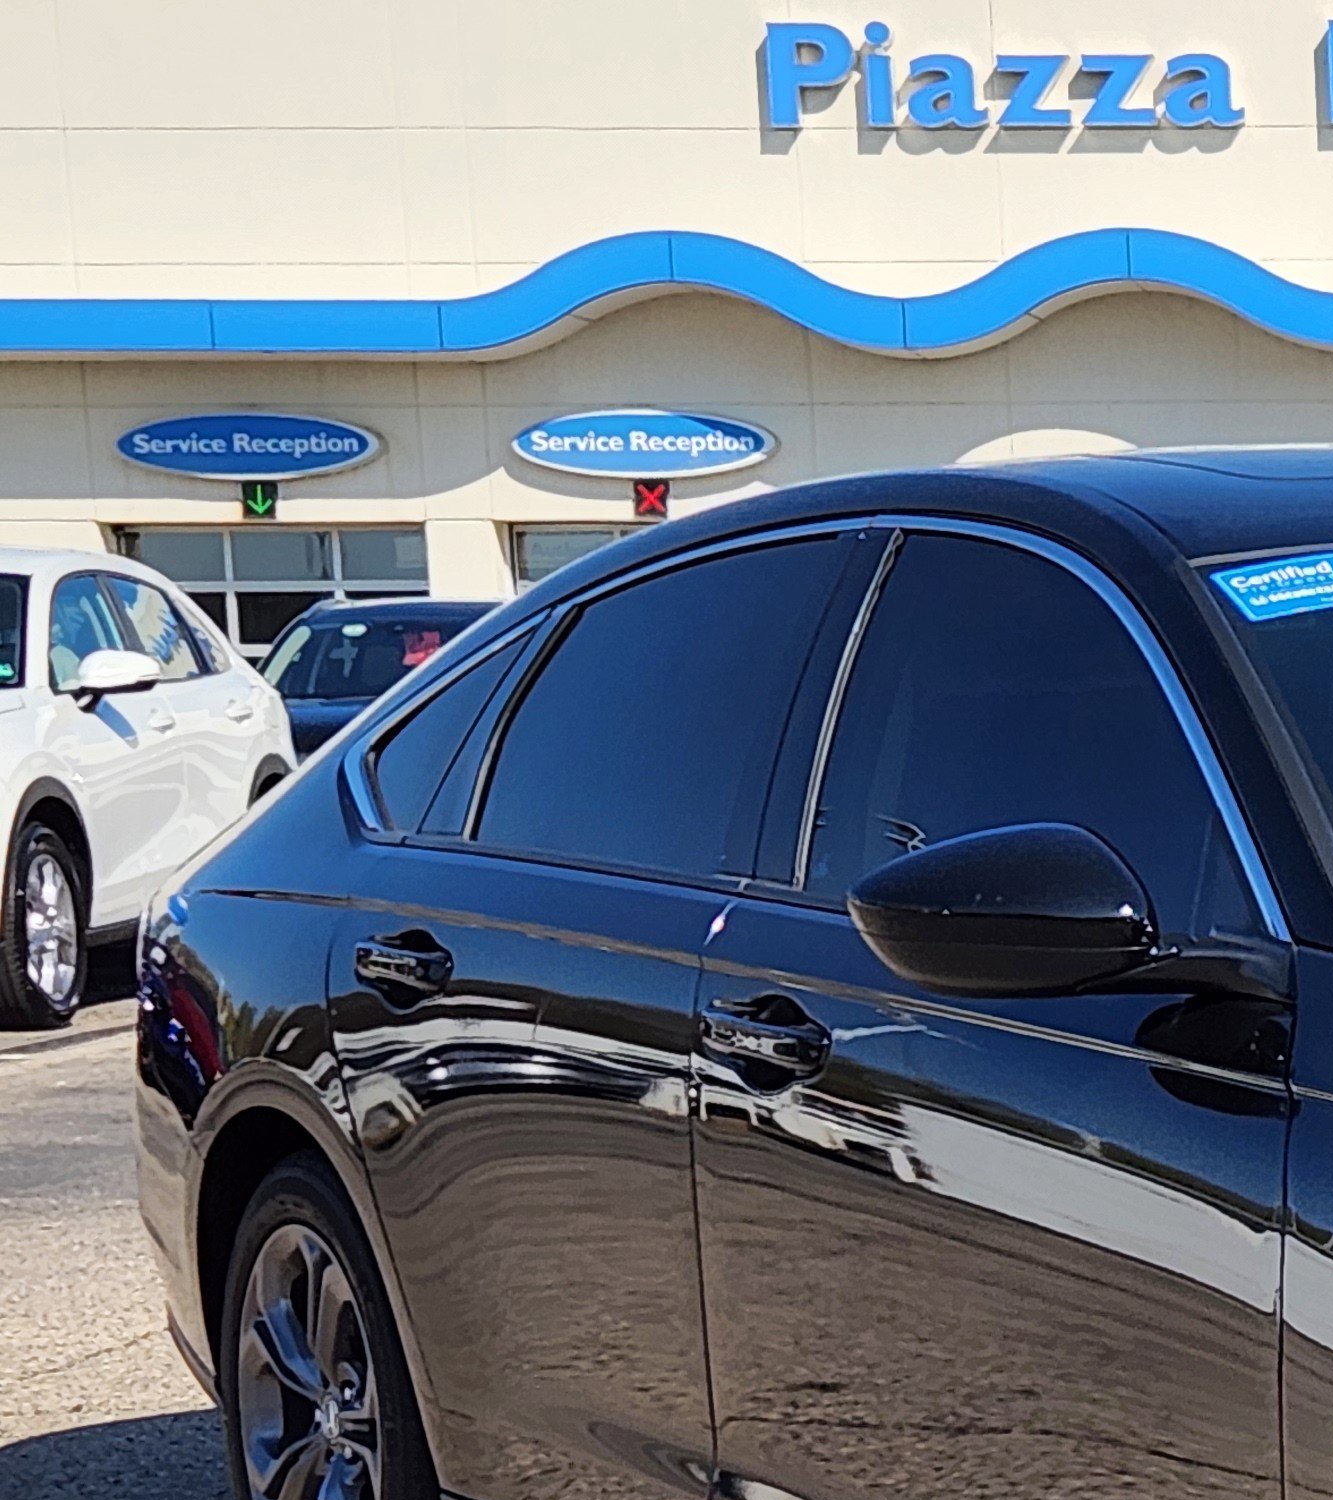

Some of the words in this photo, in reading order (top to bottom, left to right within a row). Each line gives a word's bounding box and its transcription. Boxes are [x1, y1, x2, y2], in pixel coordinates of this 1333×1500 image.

[765, 23, 1244, 127] Piazza
[133, 432, 227, 454] Service
[232, 432, 359, 459] Reception
[530, 430, 624, 451] Service
[629, 430, 754, 457] Reception
